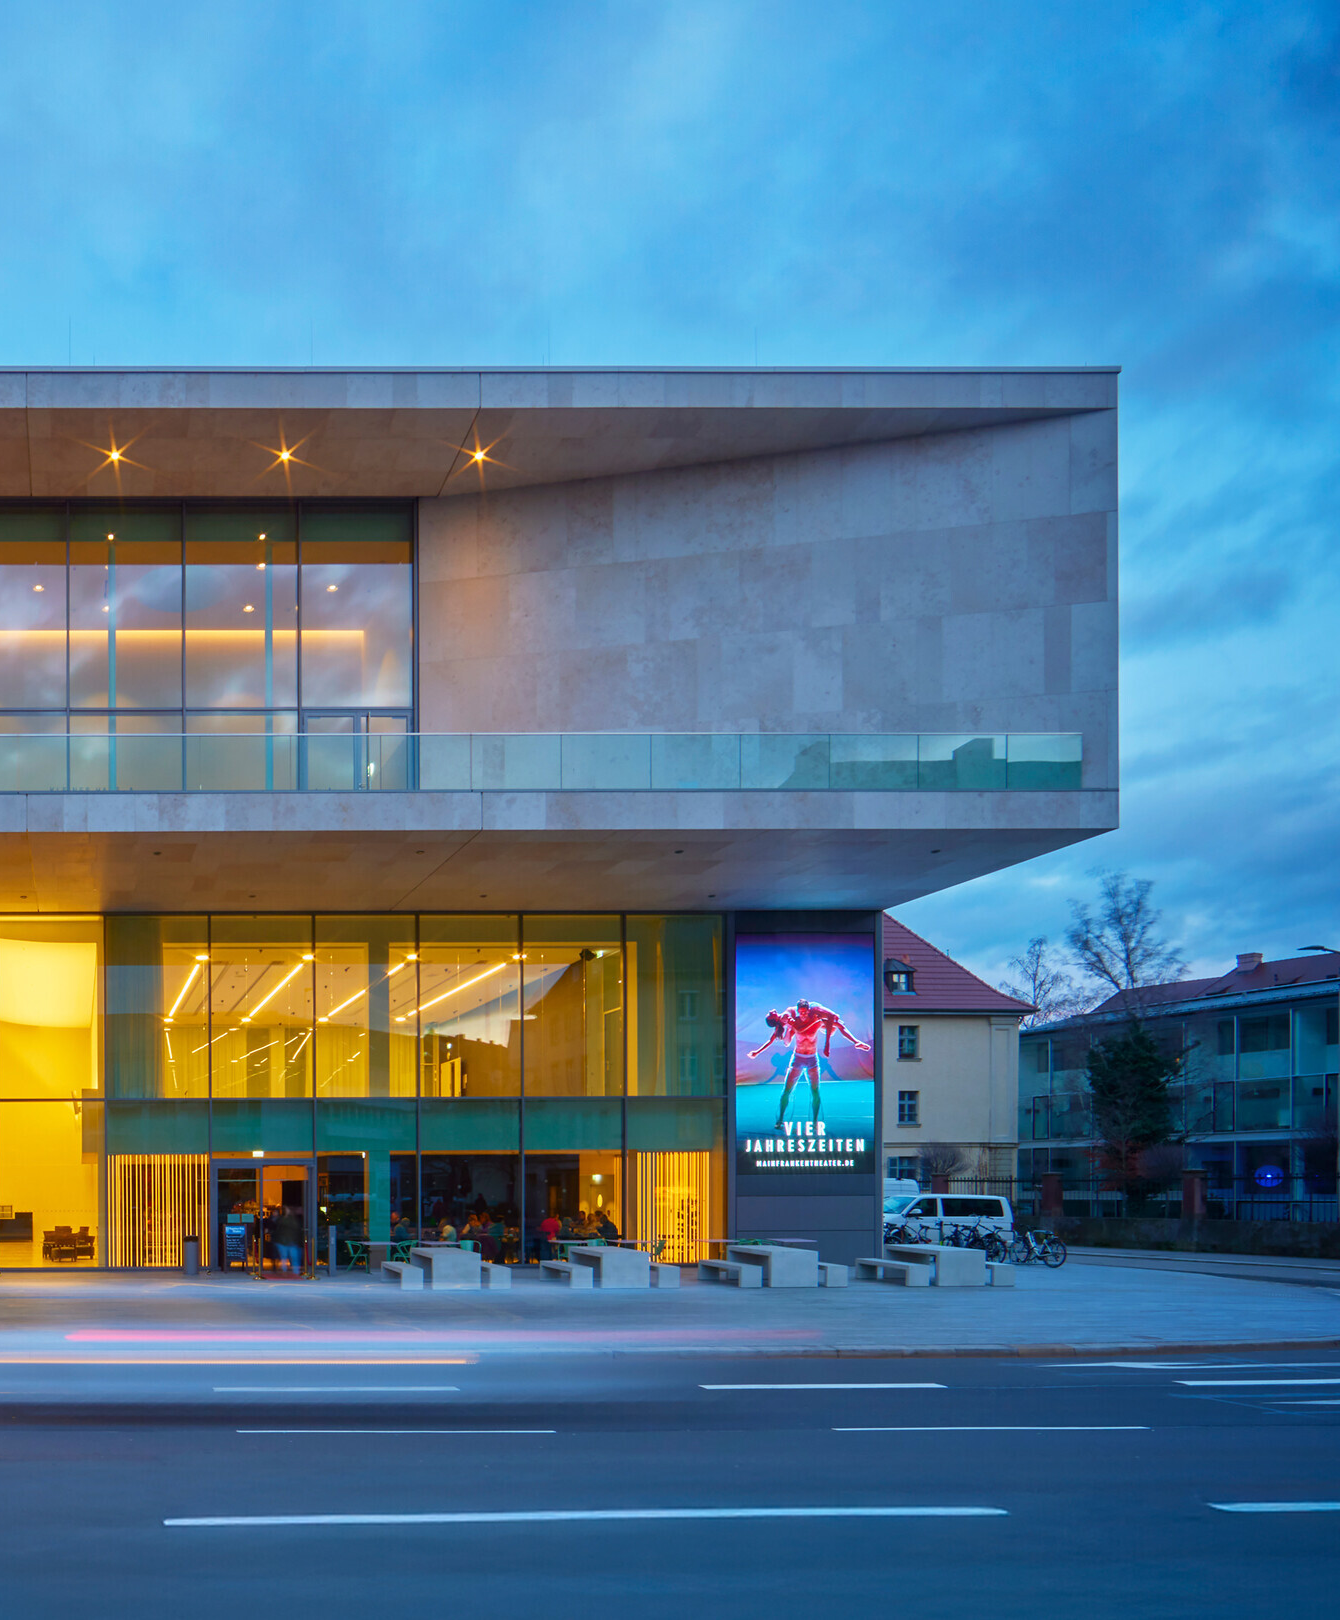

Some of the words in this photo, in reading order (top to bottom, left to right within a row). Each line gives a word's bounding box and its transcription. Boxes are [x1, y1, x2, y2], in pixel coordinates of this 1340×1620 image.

[783, 1121, 826, 1136] VIER
[745, 1138, 865, 1153] JAHRESZEITEN
[755, 1159, 855, 1168] MAINFRANKENTHEATER.DE
